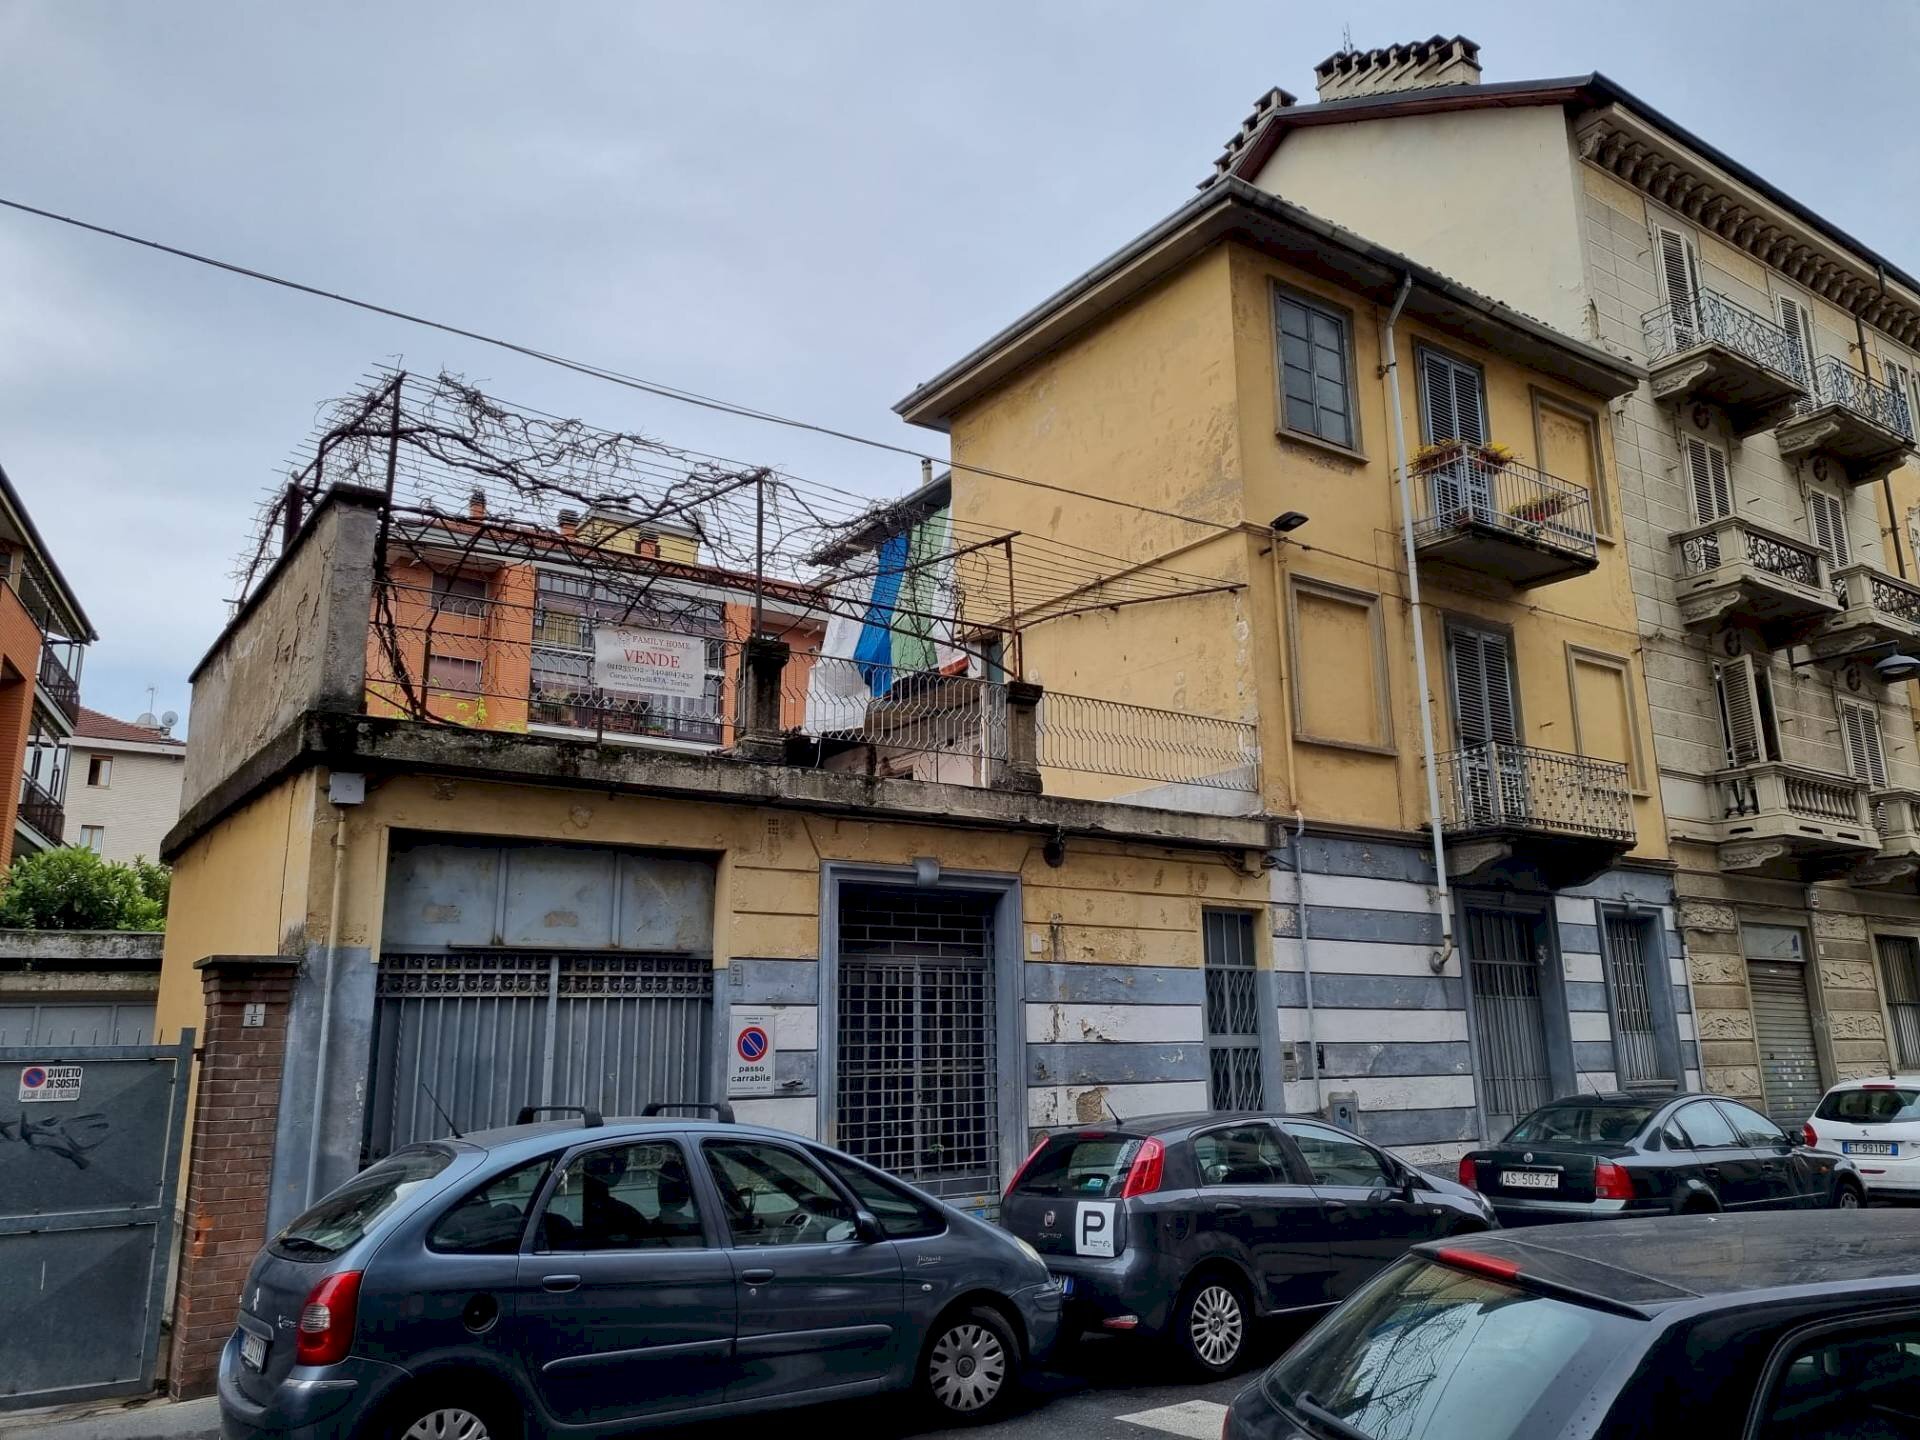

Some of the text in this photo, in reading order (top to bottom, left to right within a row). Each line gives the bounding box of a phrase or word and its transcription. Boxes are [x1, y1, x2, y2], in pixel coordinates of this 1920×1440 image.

[632, 635, 664, 647] FAMILY
[666, 639, 690, 650] HOME
[624, 649, 680, 668] VENDE
[48, 1068, 82, 1078] DIVIETO
[731, 1074, 771, 1082] carrabile
[46, 1078, 80, 1089] DI SOSTA
[1848, 1143, 1860, 1153] ET
[1505, 1172, 1557, 1187] AS 503 ZF
[1083, 1210, 1106, 1246] P
